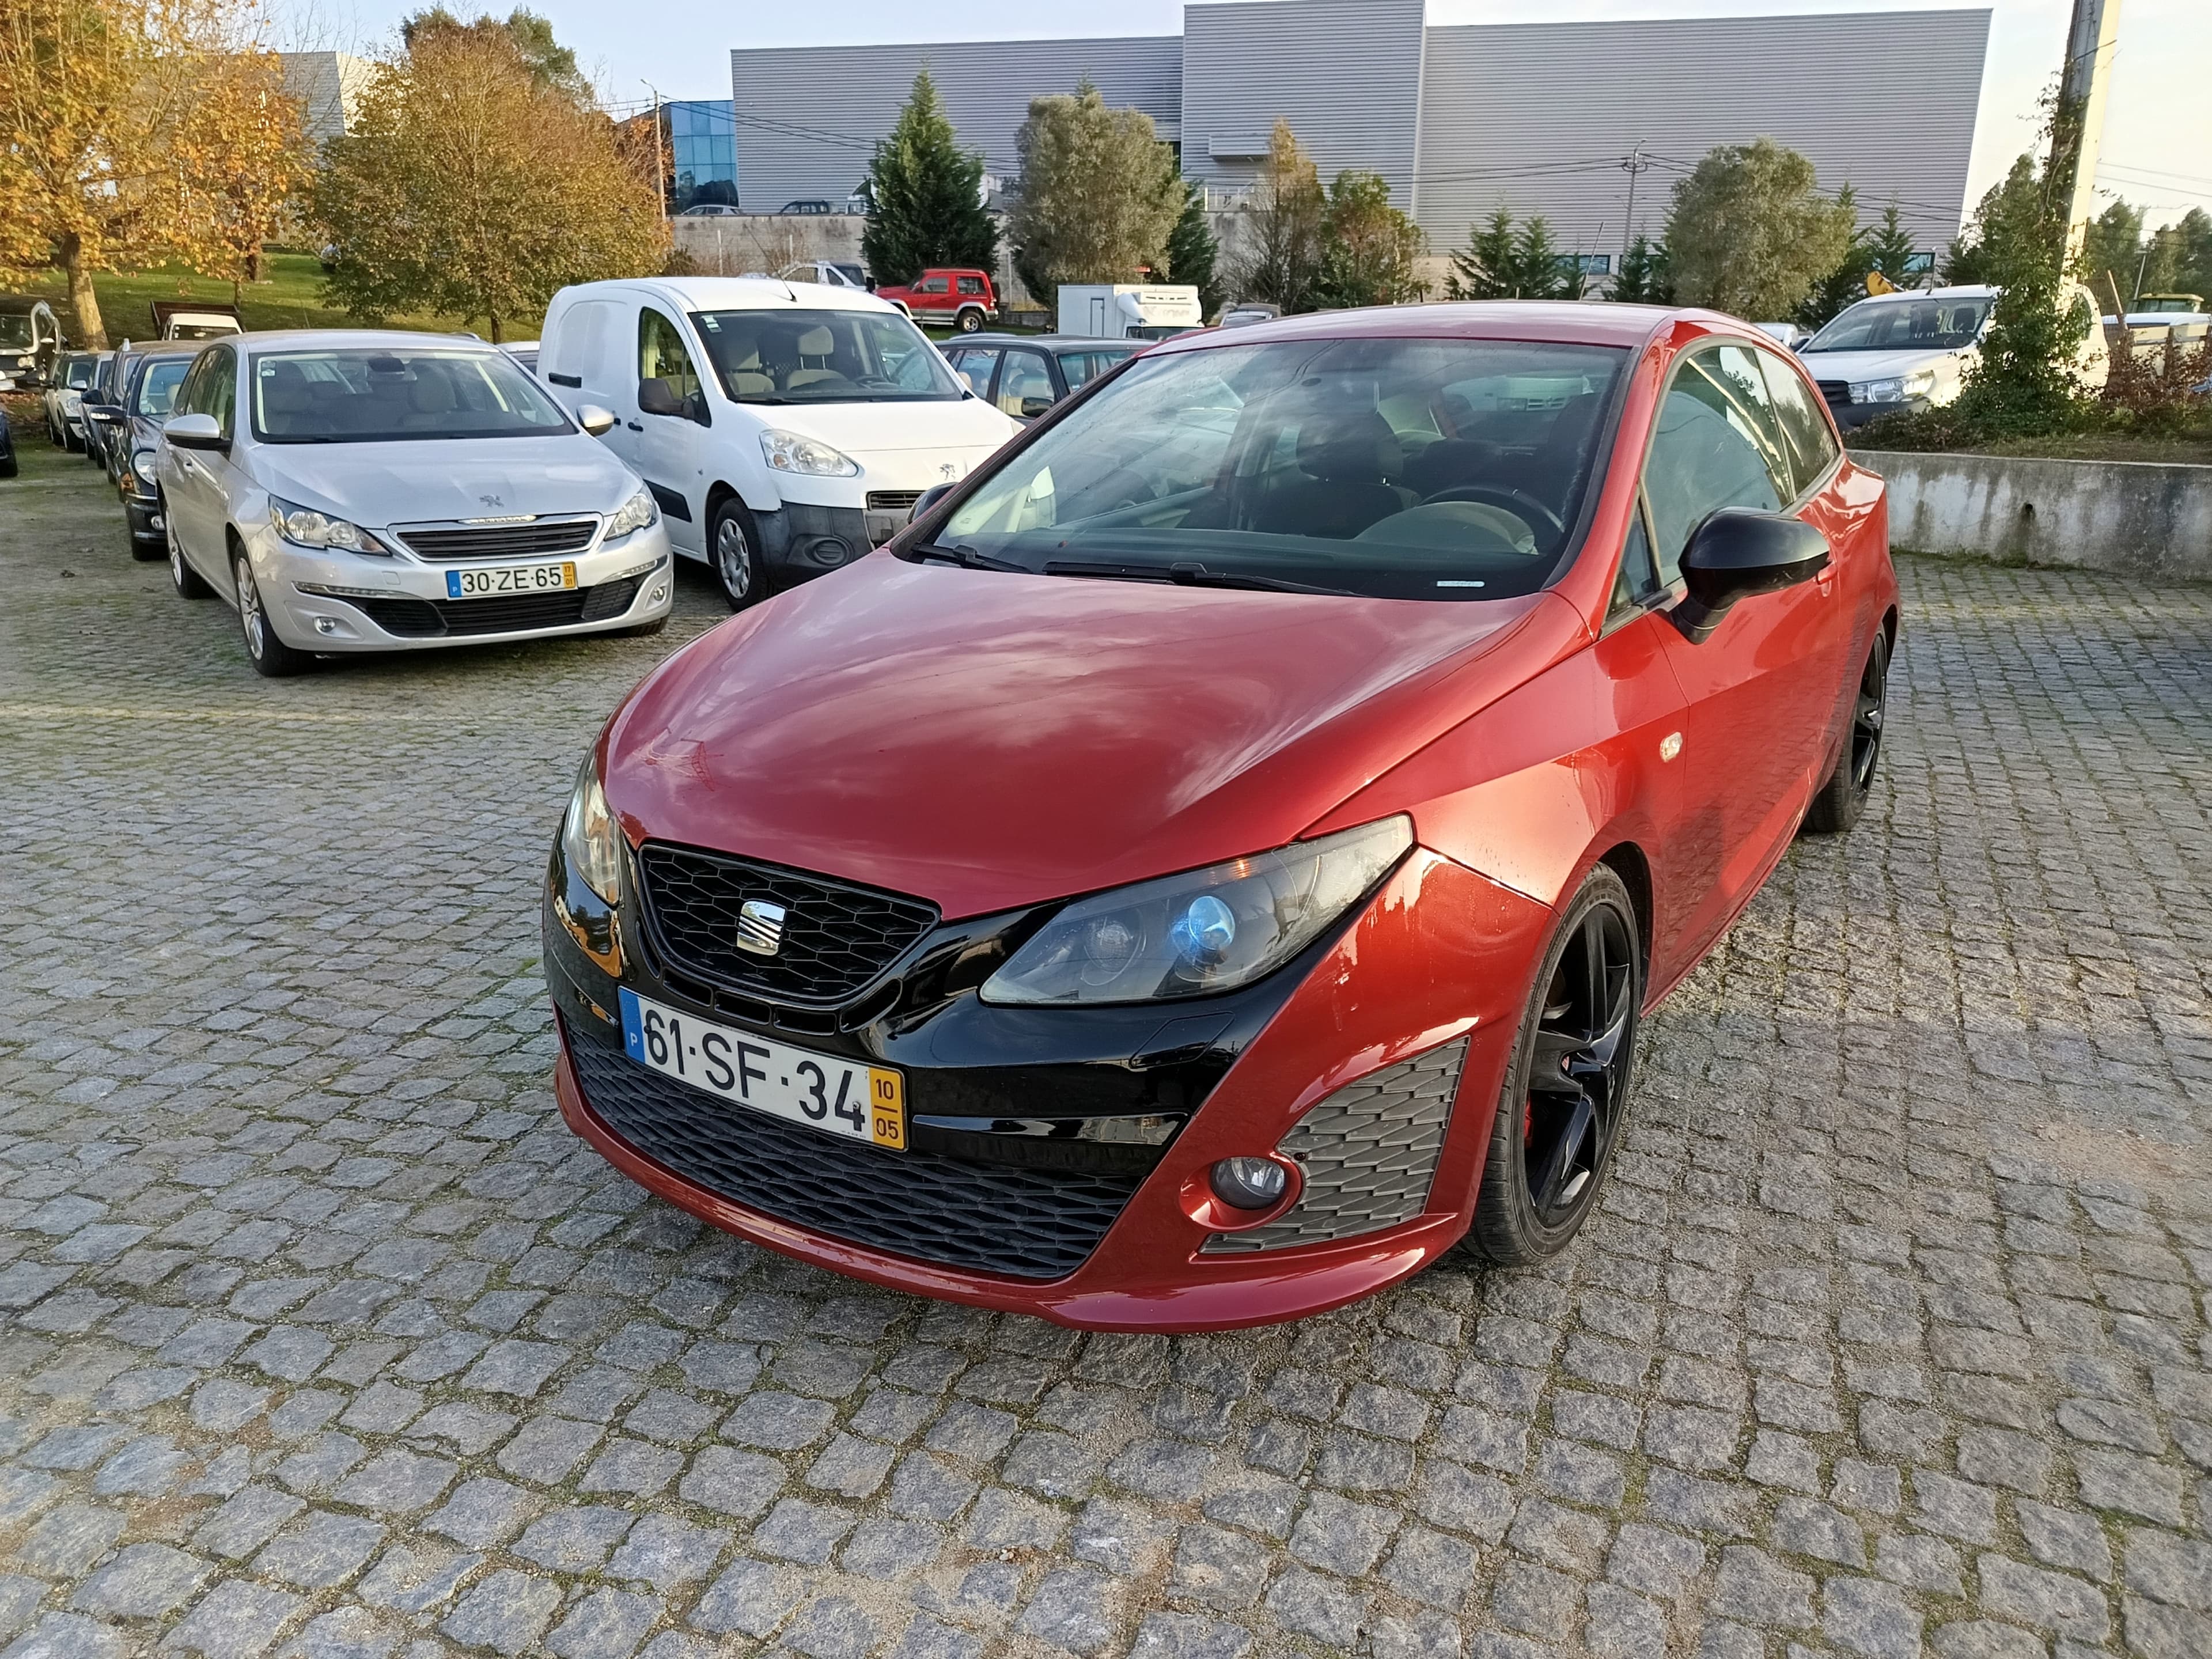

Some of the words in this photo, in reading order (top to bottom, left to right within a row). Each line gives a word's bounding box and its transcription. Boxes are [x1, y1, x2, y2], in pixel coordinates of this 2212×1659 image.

[630, 1032, 638, 1047] P
[876, 1078, 894, 1100] 10
[876, 1118, 899, 1140] 05
